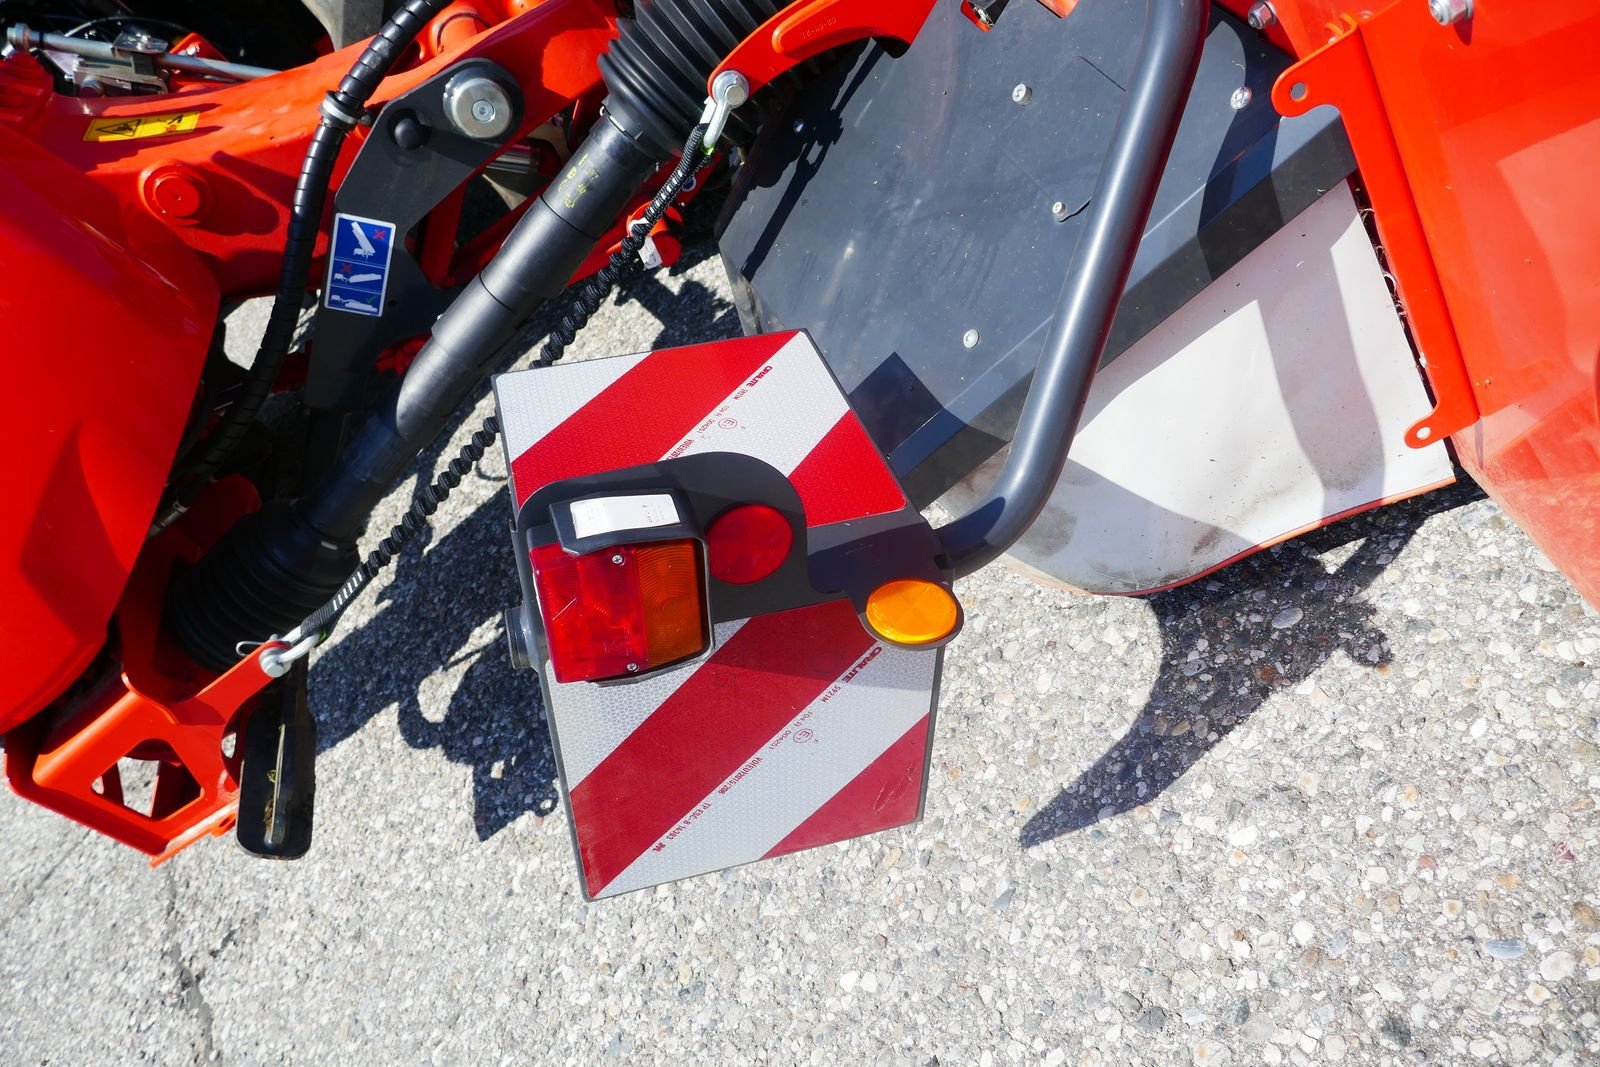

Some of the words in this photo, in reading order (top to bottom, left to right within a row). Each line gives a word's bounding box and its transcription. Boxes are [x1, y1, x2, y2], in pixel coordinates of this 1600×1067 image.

[746, 365, 773, 388] ORALITE
[841, 646, 882, 683] ORALITE
[820, 685, 841, 703] 5921M
[800, 711, 813, 721] 104
[768, 729, 792, 750] 004251
